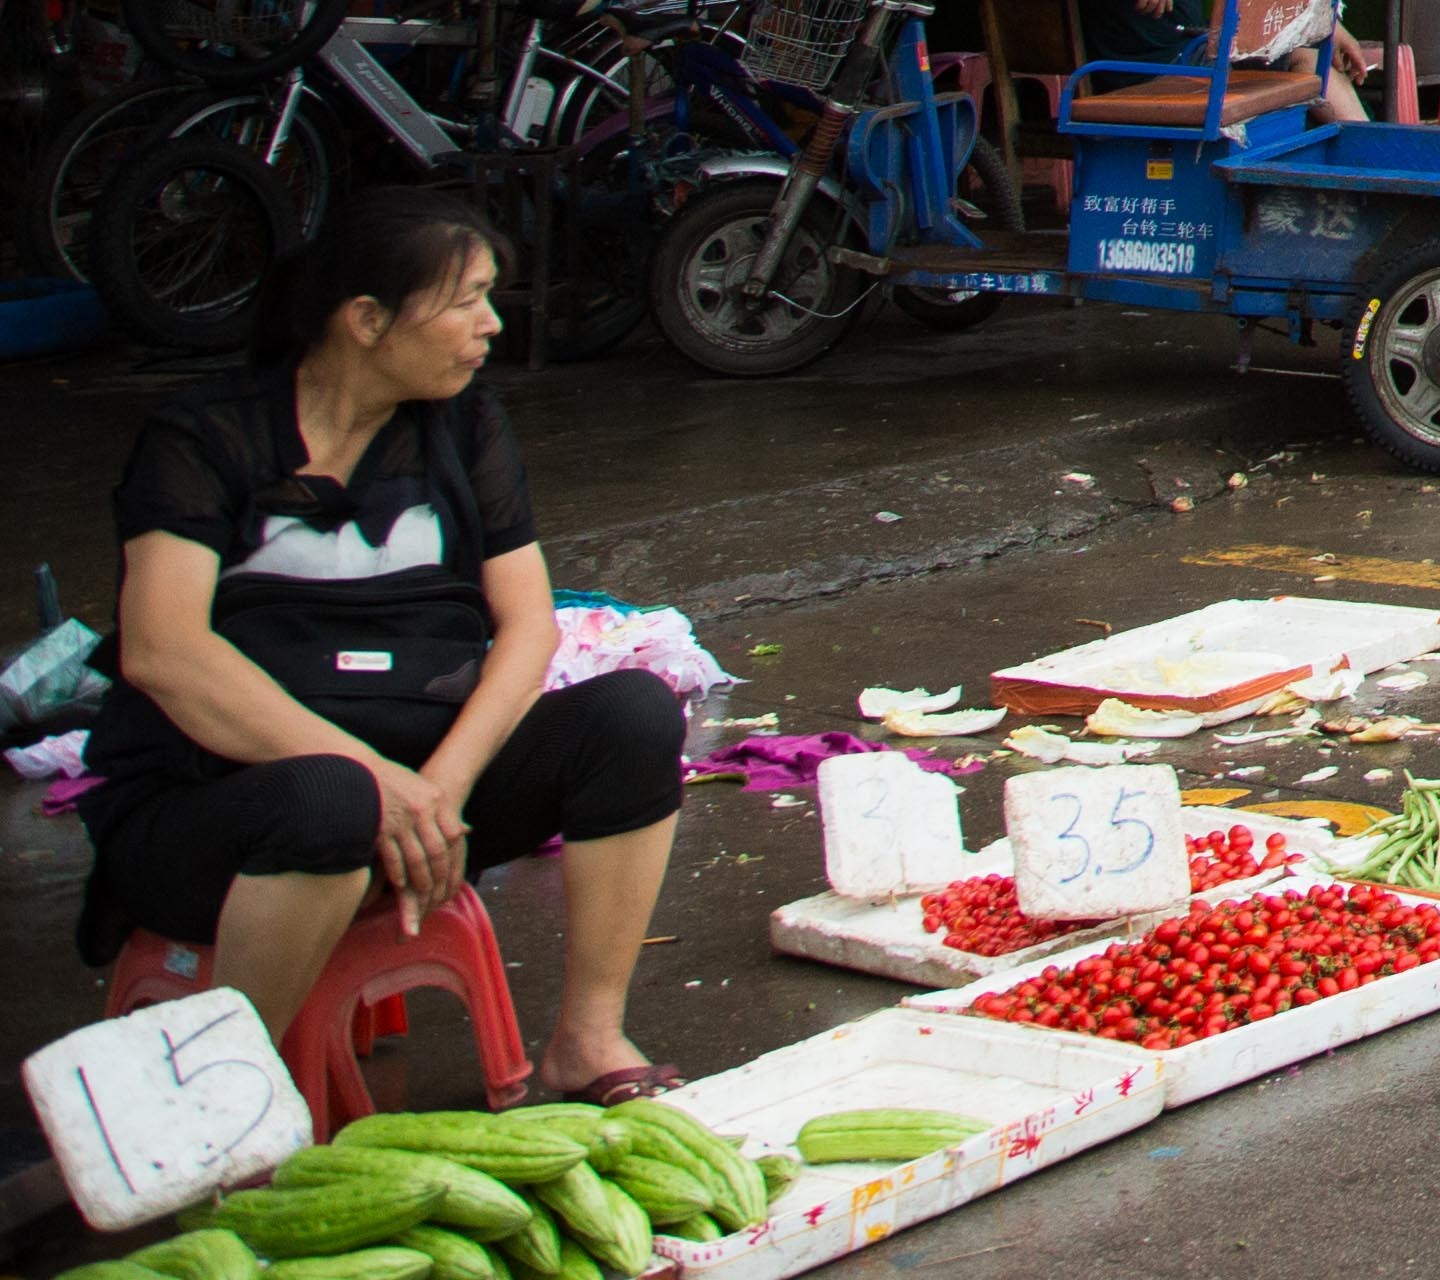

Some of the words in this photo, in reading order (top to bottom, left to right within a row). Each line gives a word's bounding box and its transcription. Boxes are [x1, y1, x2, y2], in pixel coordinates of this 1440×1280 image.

[1083, 195, 1177, 216] 致富好帮手
[1121, 218, 1216, 240] 台铃三轮车
[1051, 787, 1156, 884] 3.5
[75, 1008, 275, 1196] 1.5
